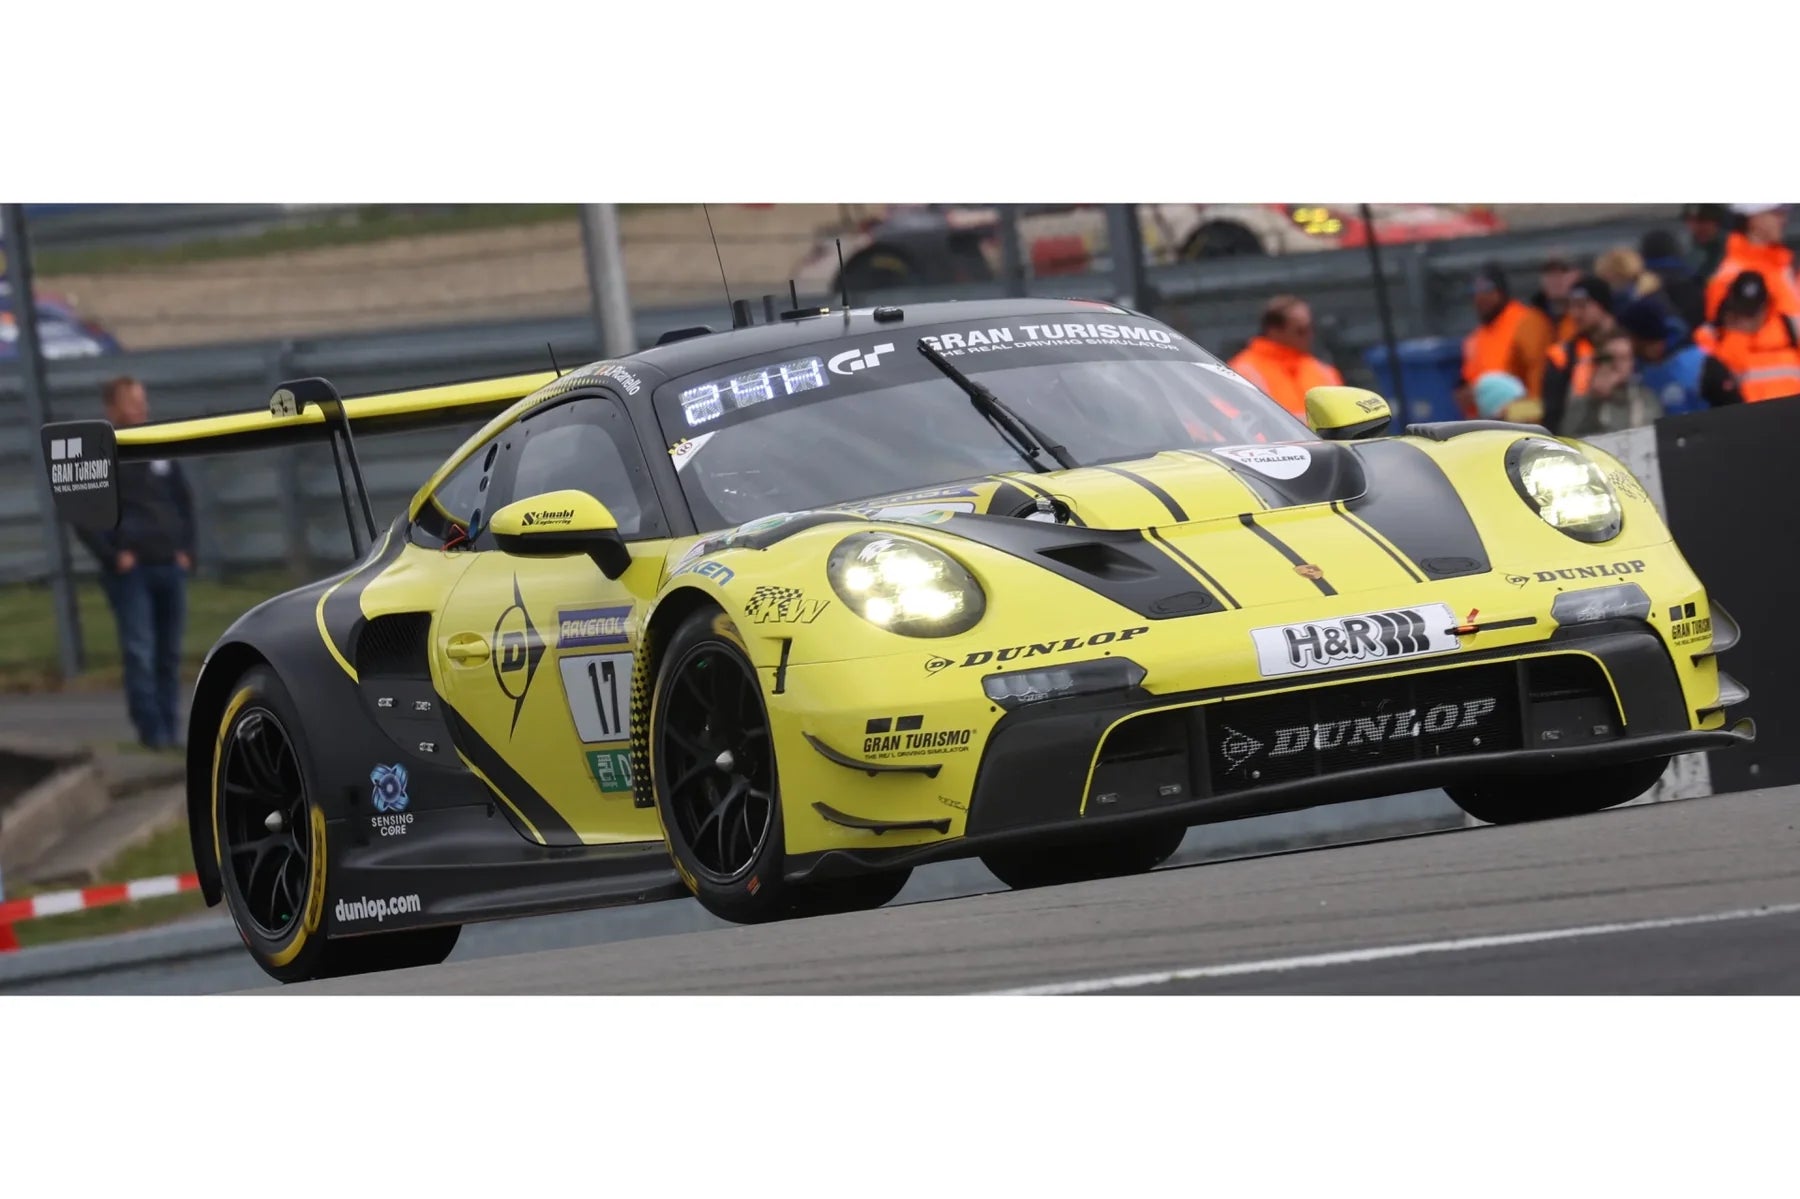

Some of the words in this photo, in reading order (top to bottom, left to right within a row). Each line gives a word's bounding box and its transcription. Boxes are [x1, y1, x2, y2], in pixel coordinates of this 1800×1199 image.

[921, 327, 1014, 351] GRAN
[1019, 323, 1171, 344] TURISMO
[940, 348, 966, 357] HE
[967, 344, 1013, 353] REAL
[1014, 338, 1083, 348] DRIVING
[1085, 338, 1179, 351] SIMULATOR
[52, 462, 73, 484] GRAN
[74, 458, 109, 481] TURISMO
[1254, 455, 1306, 463] CHALLENGE
[1532, 560, 1646, 583] DUNLOP
[753, 597, 831, 623] KW
[958, 626, 1150, 668] DUNLOP
[1283, 617, 1379, 666] H&R
[587, 660, 622, 736] 17
[1268, 697, 1497, 757] DUNLOP
[863, 735, 902, 753] GRAN
[905, 729, 971, 750] TURISMO
[897, 749, 926, 757] DRIVING
[927, 746, 969, 755] SIMULATOR
[371, 813, 414, 828] SENSING
[380, 824, 407, 837] CORE
[335, 893, 421, 922] dunlop.com
